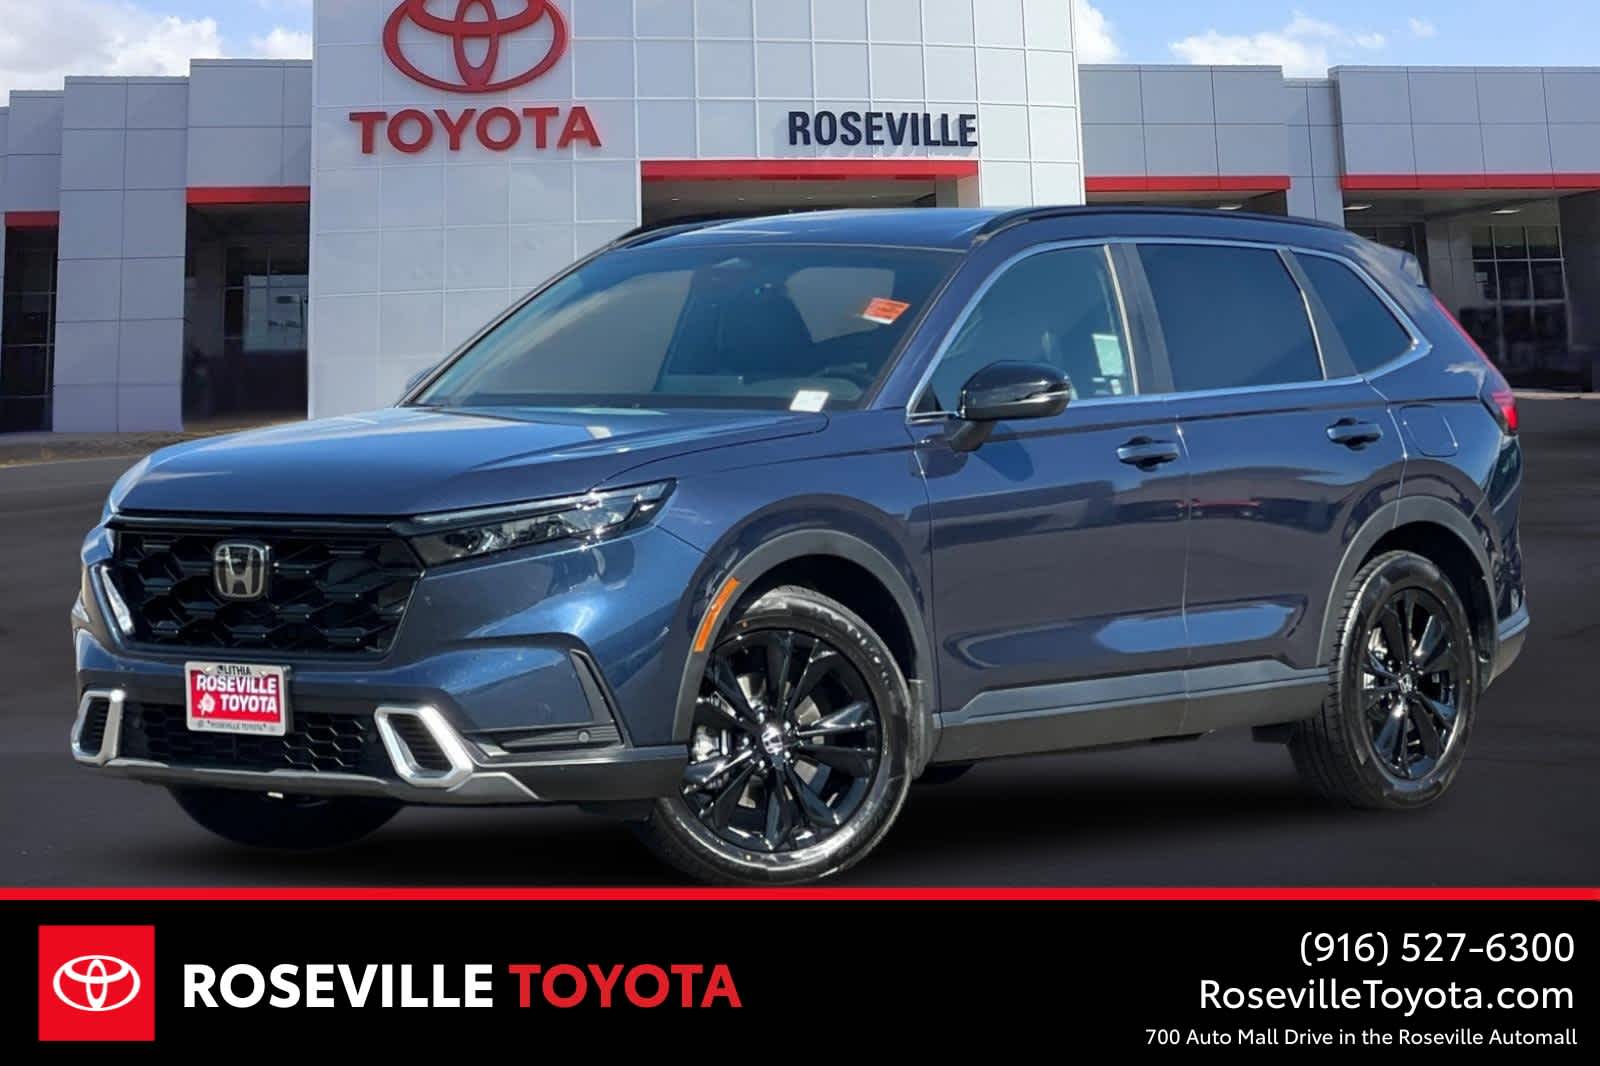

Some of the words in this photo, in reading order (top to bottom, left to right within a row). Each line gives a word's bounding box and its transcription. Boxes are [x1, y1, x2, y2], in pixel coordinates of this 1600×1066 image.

[349, 106, 602, 154] TOYOTA
[788, 110, 978, 147] ROSEVILLE
[196, 674, 277, 694] ROSEVILLE
[220, 694, 277, 714] TOYOTA
